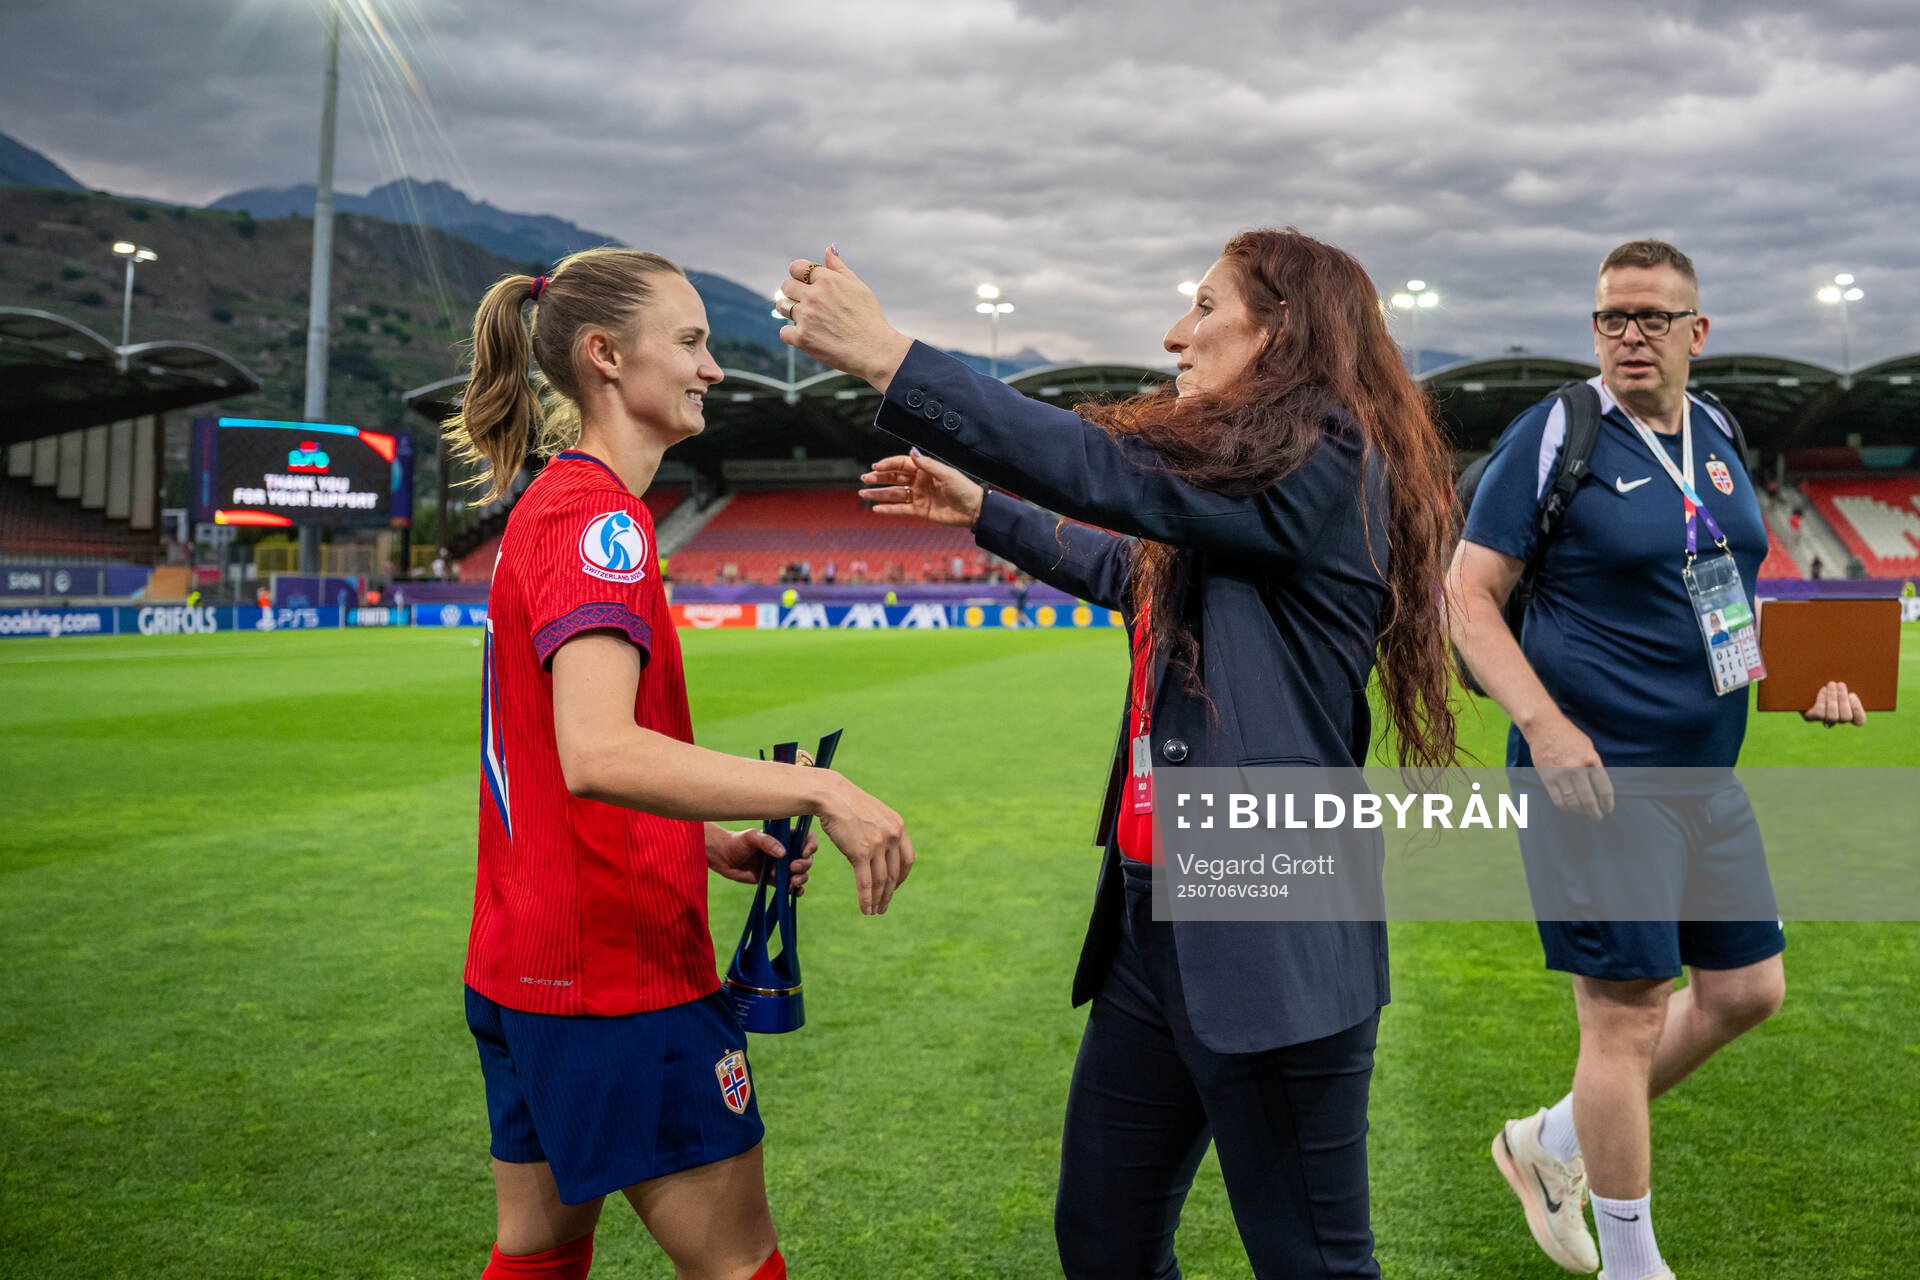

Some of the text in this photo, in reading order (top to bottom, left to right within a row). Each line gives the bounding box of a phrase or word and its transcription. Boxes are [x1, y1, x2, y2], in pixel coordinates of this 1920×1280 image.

[264, 474, 350, 492] THANK YOU
[233, 487, 378, 509] FOR YOUR SUPPORT
[585, 565, 642, 580] SWITZERLAND 2025
[138, 606, 217, 635] GRIFOLS
